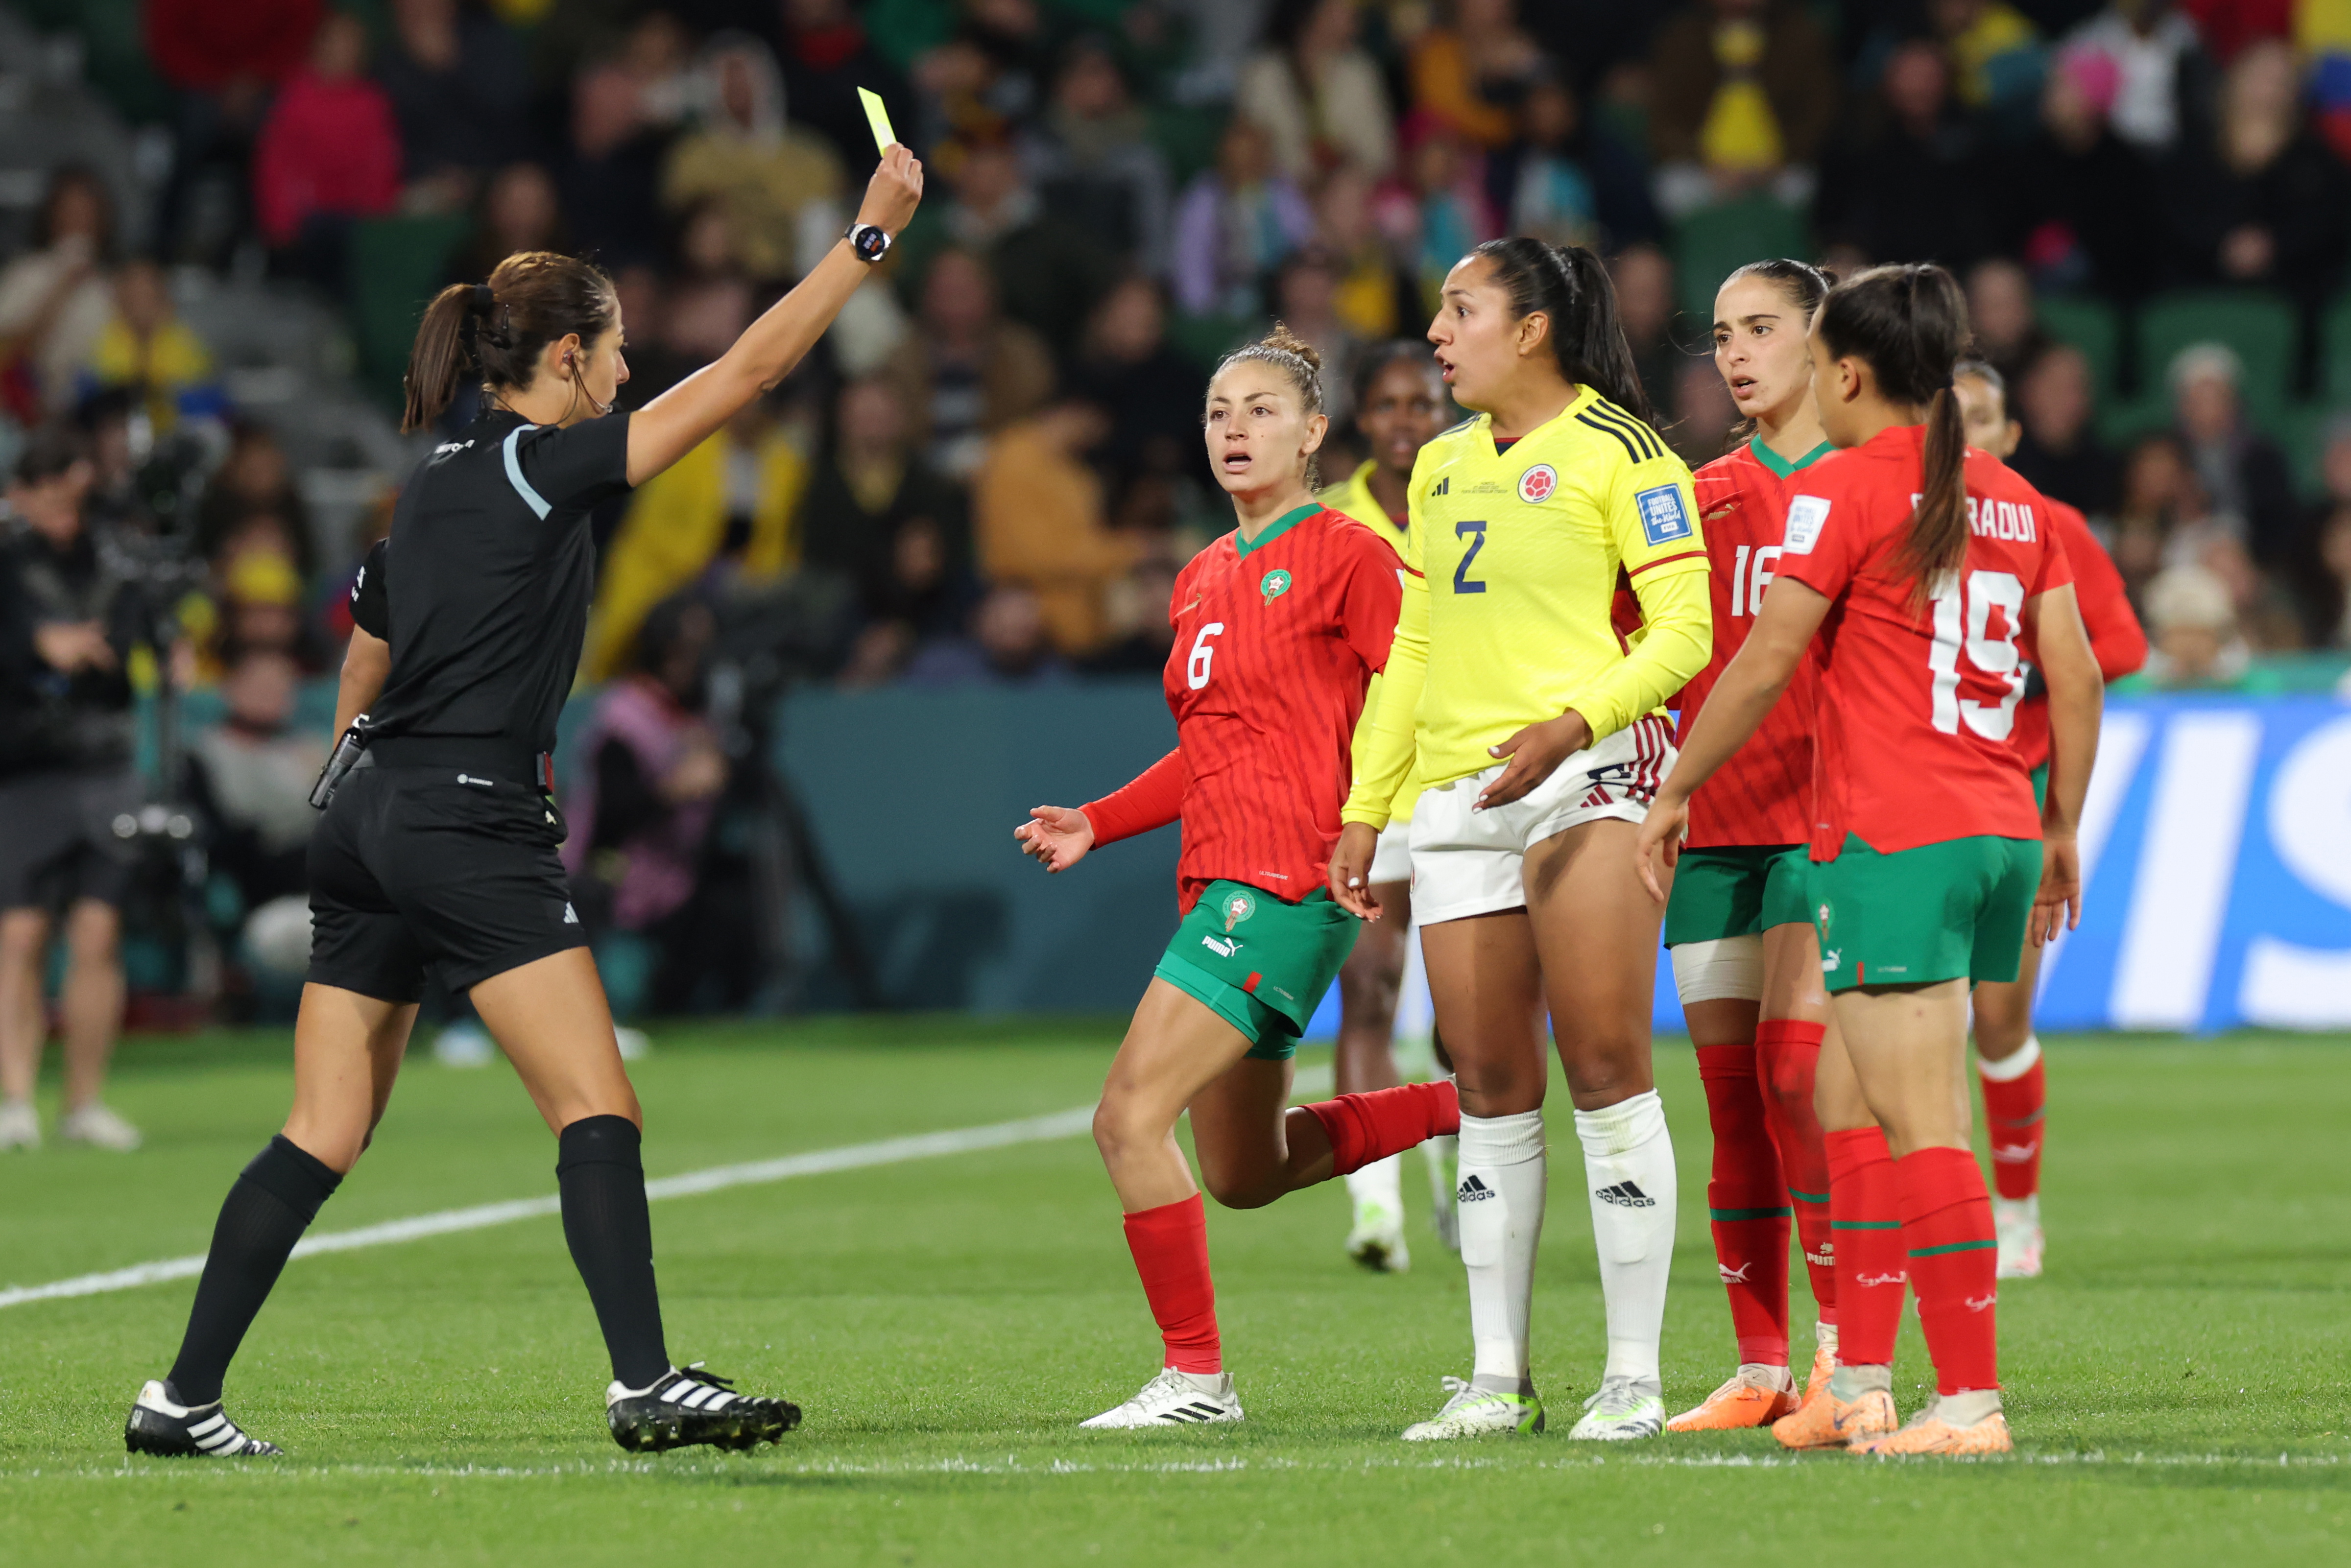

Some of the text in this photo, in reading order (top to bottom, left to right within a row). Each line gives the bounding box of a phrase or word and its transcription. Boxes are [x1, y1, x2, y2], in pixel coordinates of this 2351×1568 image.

[1647, 493, 1675, 507] FOOTBALL
[1649, 500, 1678, 517] UNITES
[1453, 521, 1487, 594] 2
[1731, 545, 1784, 617] 16
[1187, 622, 1224, 690] 6
[1928, 567, 2025, 741] 19
[1201, 935, 1231, 957] PUMA
[1457, 1190, 1495, 1203] adidas
[1595, 1190, 1655, 1207] adidas
[1806, 1252, 1836, 1266] PUM
